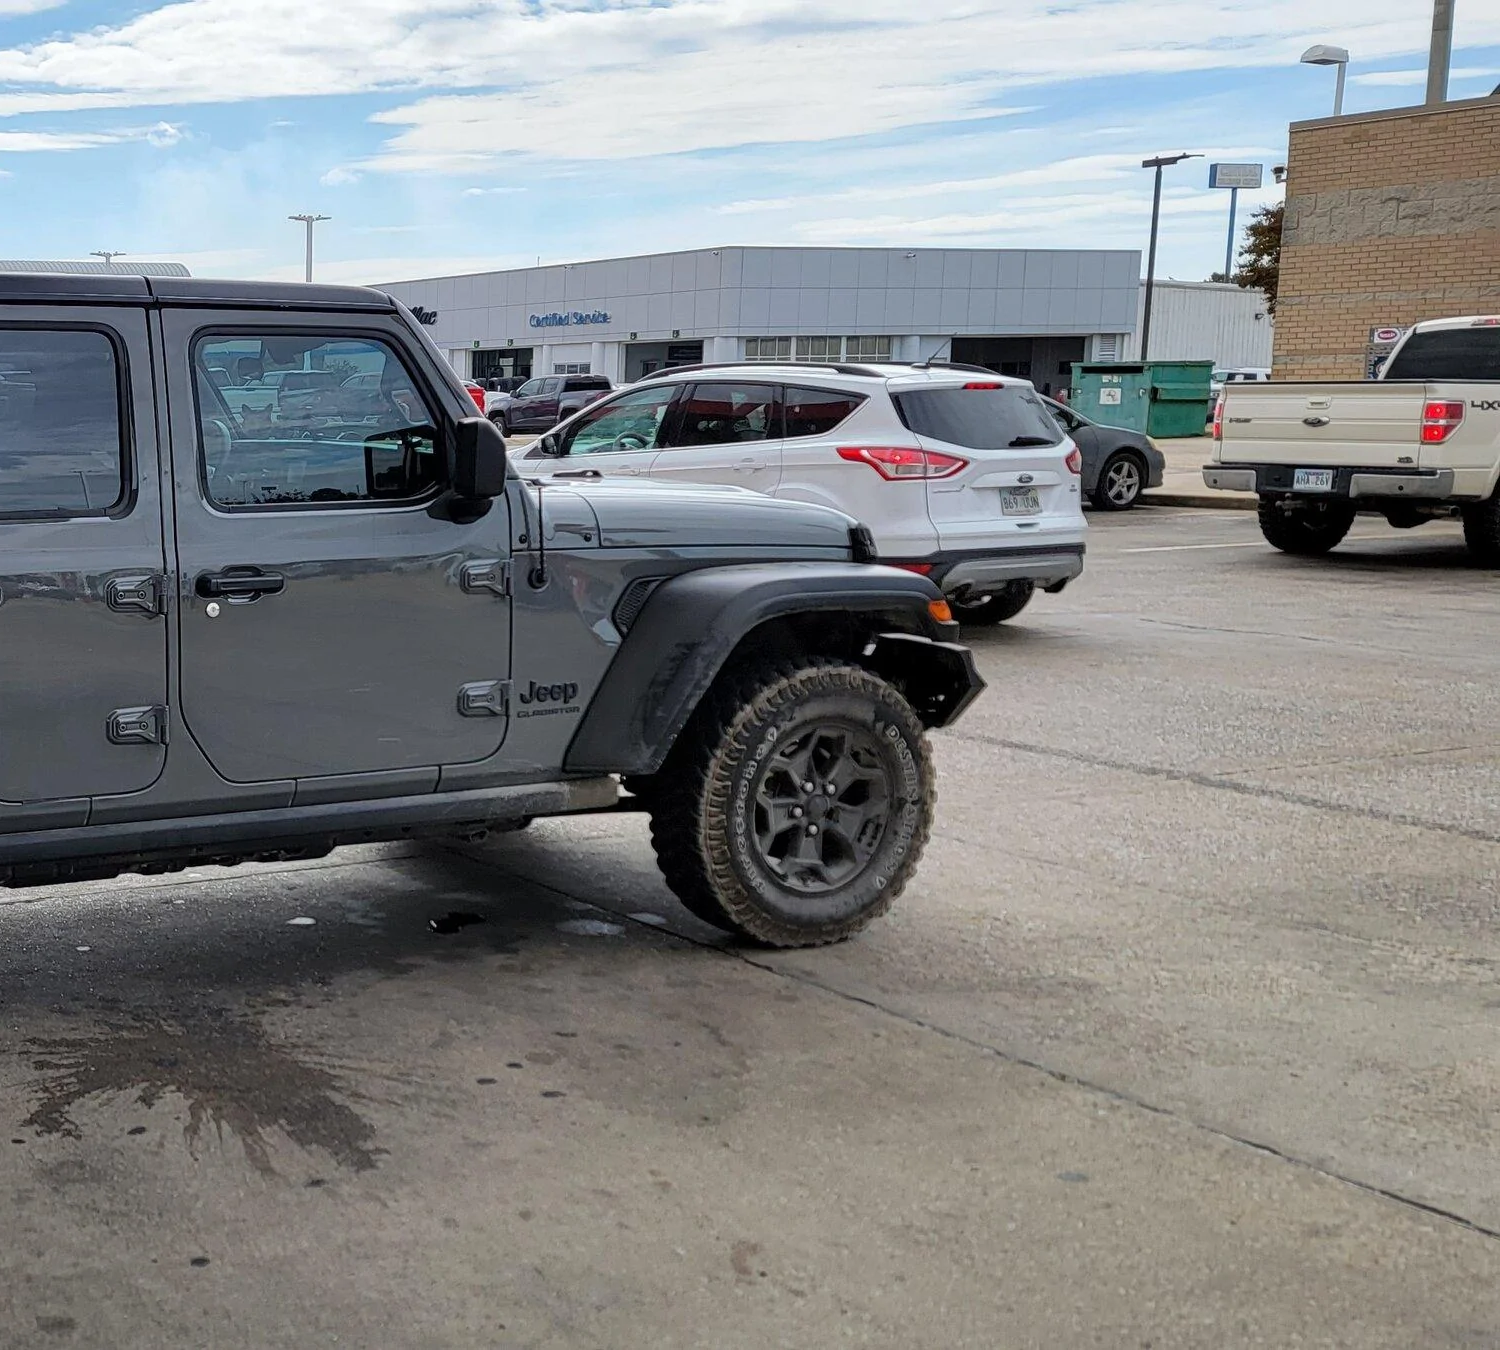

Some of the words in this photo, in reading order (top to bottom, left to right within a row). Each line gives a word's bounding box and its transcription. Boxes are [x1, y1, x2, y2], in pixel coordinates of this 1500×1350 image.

[529, 311, 570, 328] Certified
[572, 310, 612, 325] Service
[1471, 401, 1500, 411] 4X
[519, 681, 579, 704] Jeep
[517, 706, 580, 718] GLADIATOR
